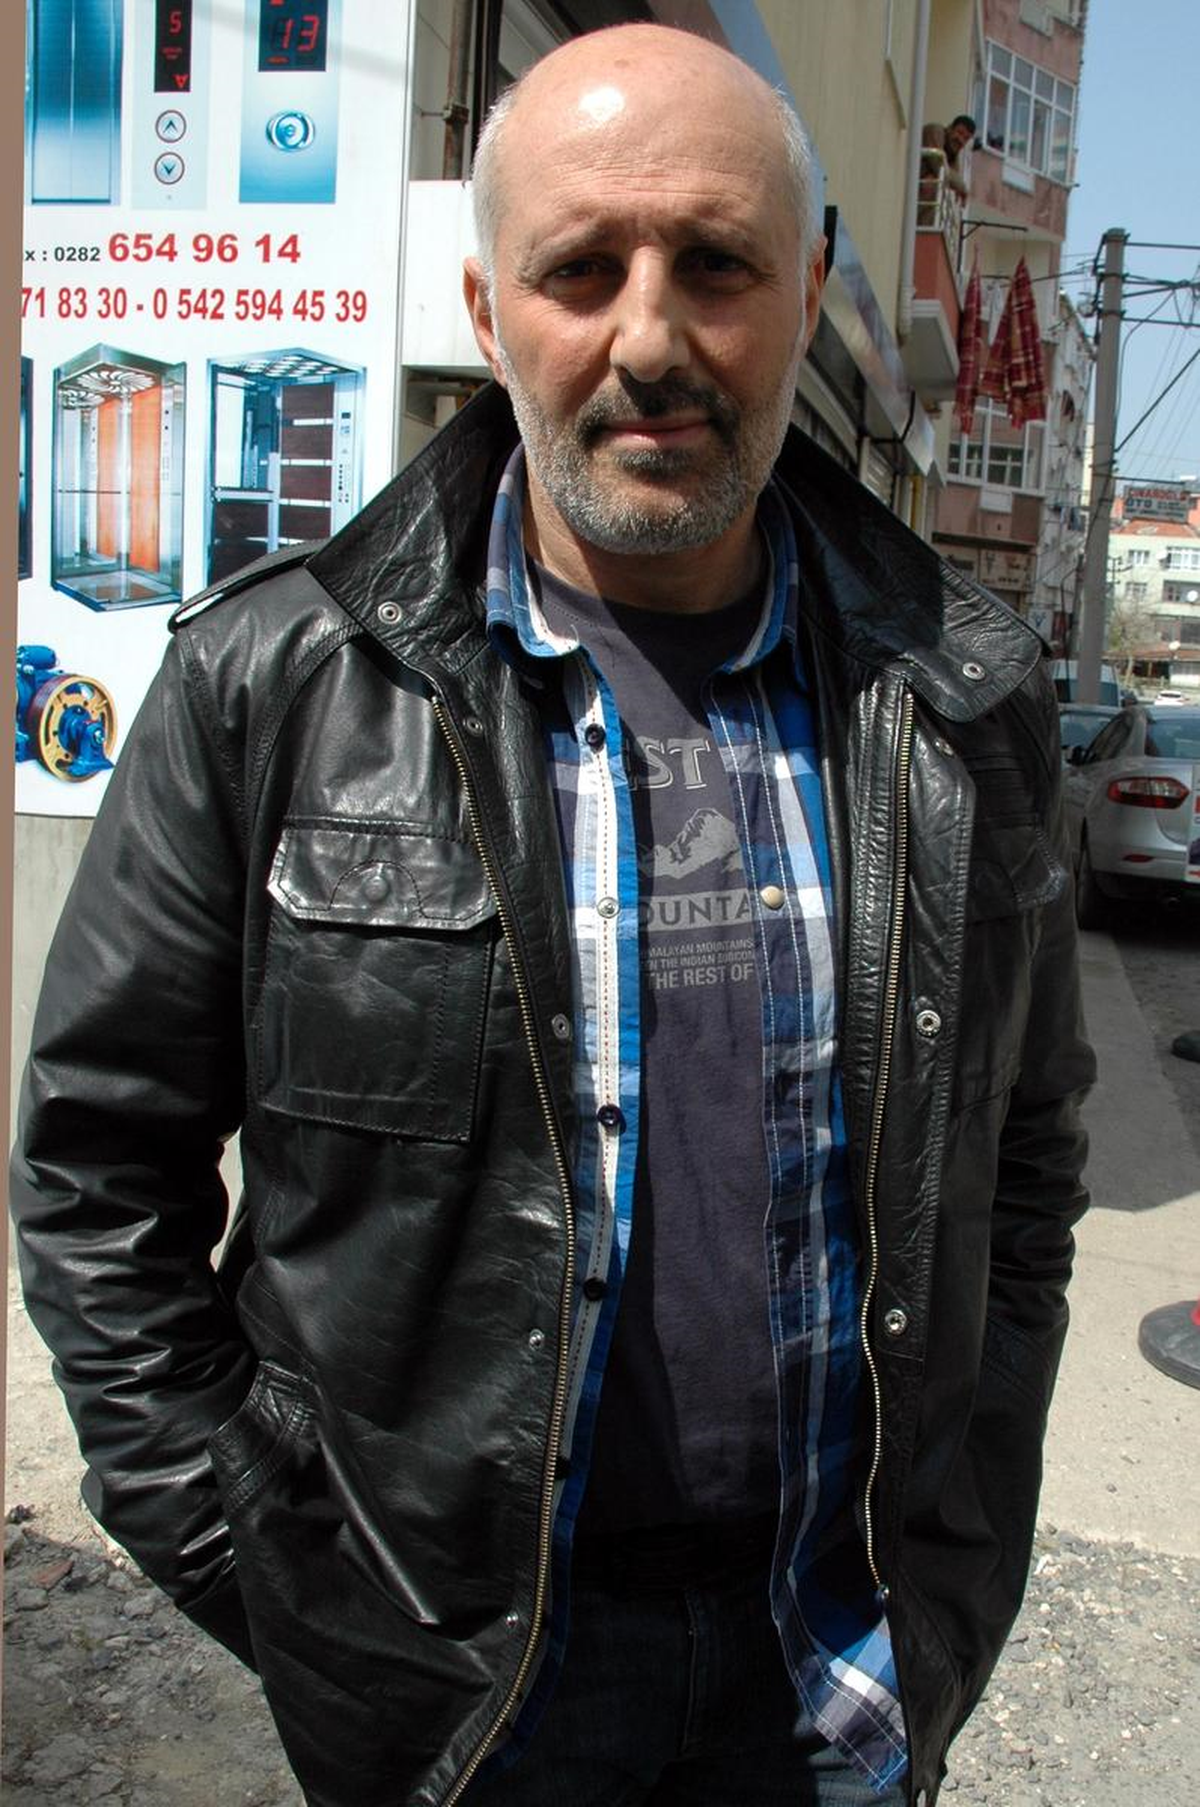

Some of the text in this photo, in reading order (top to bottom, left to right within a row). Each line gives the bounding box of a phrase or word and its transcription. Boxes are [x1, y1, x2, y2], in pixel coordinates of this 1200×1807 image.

[282, 15, 320, 51] 13
[54, 246, 101, 262] 0282
[108, 233, 178, 262] 654
[192, 233, 239, 263] 96
[255, 234, 301, 263] 14
[58, 287, 87, 318] 83
[97, 287, 127, 319] 30
[153, 288, 167, 319] 0
[177, 288, 225, 320] 542
[234, 289, 284, 321] 594
[292, 290, 325, 322] 45
[335, 290, 368, 323] 39
[683, 966, 725, 987] REST
[731, 963, 754, 981] OF
